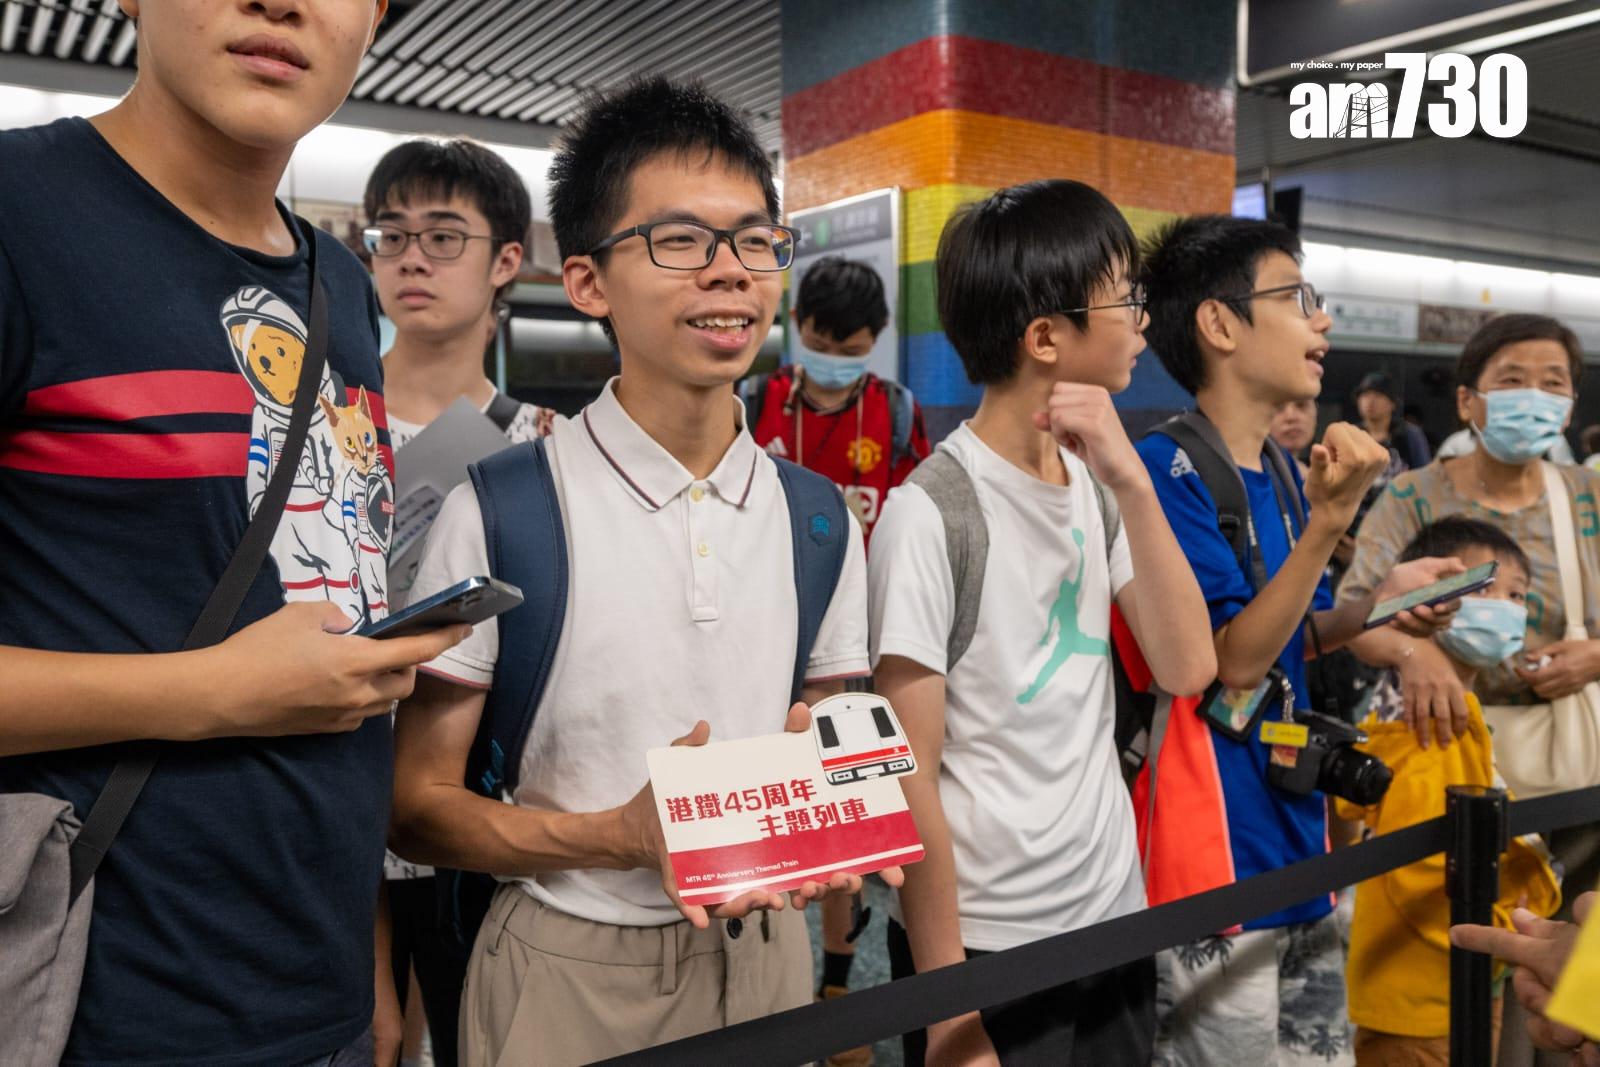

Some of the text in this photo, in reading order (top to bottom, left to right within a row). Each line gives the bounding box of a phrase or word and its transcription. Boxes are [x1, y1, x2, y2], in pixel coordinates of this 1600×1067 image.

[665, 778, 817, 824] 港鐵45周年
[756, 798, 869, 841] 主題列車
[685, 875, 702, 883] MTR
[716, 869, 755, 880] Anniversary
[755, 863, 781, 873] Themed
[782, 860, 799, 868] Train
